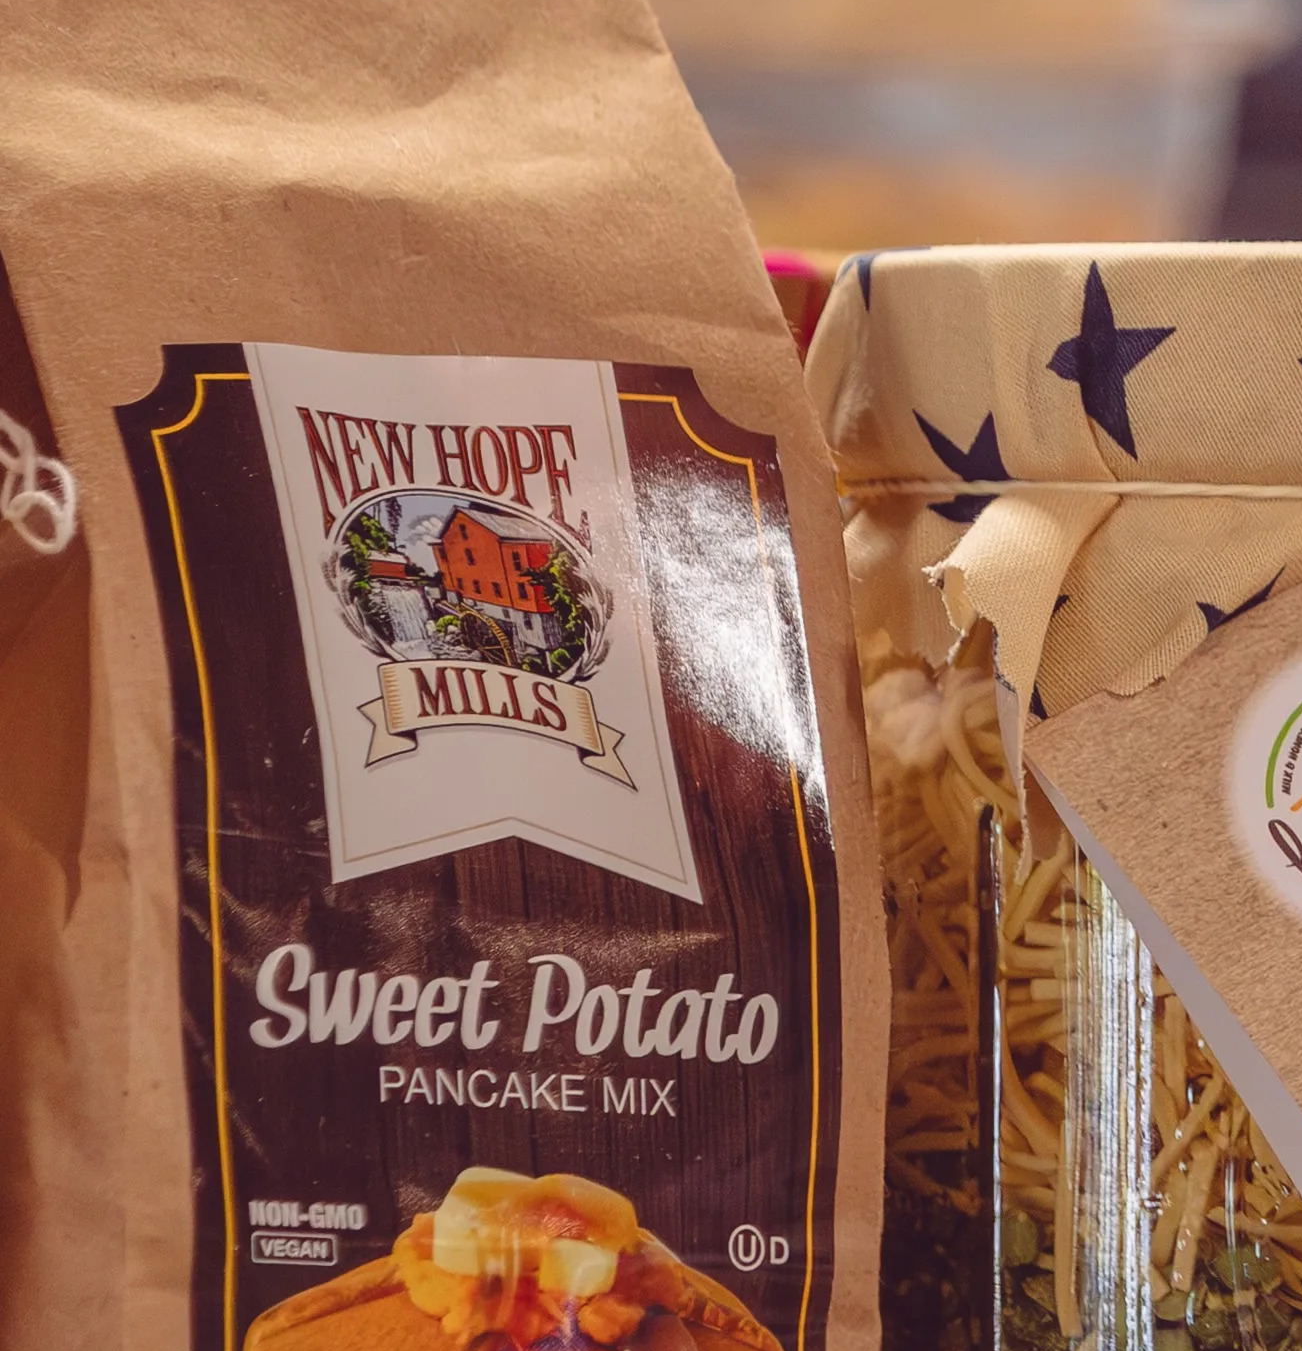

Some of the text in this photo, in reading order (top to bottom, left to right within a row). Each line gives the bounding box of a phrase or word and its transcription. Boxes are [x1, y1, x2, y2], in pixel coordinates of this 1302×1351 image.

[295, 405, 594, 557] NEW HOPE
[409, 666, 568, 732] MILLS
[248, 942, 780, 1066] Sweet Potato
[378, 1065, 678, 1118] PANCAKE MIX
[248, 1200, 367, 1231] NON-GMO
[259, 1237, 330, 1259] VEGAN
